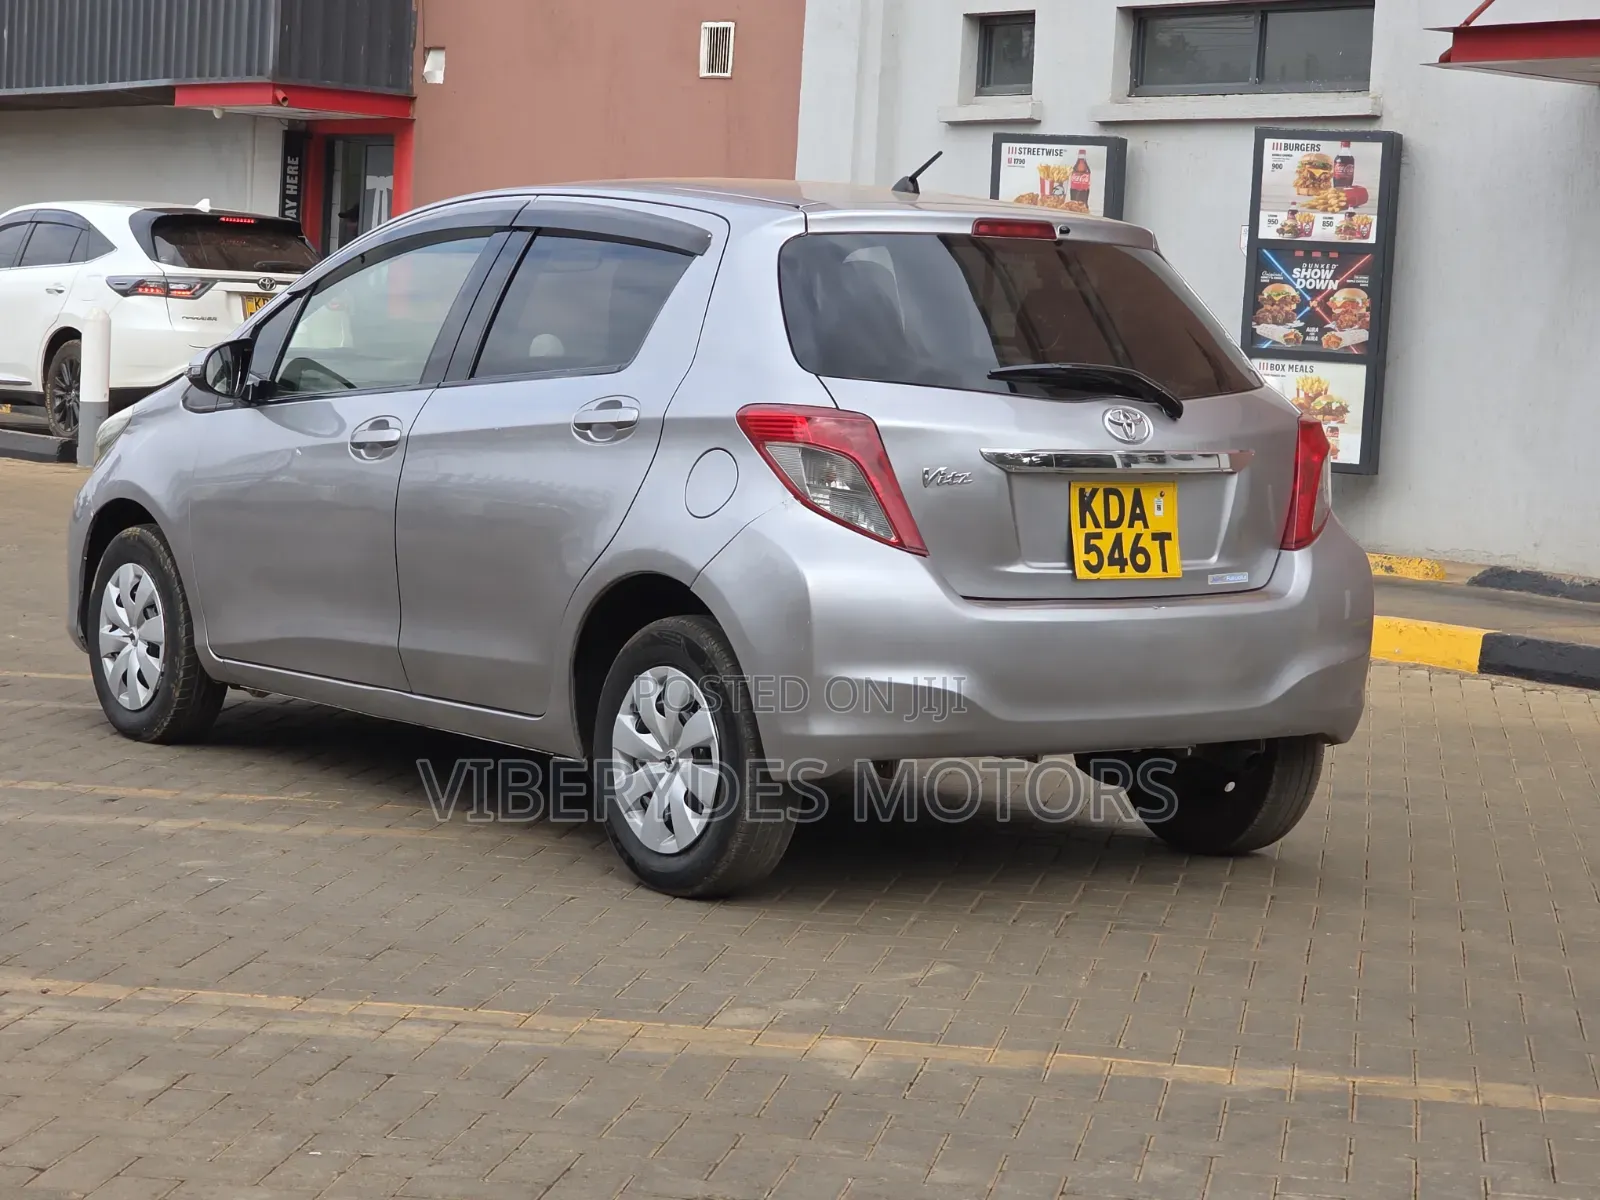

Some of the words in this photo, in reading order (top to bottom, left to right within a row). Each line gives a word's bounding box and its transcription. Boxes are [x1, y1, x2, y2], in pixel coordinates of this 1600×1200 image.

[1018, 147, 1064, 157] STREETWISE
[1283, 143, 1321, 152] BURGERS
[285, 156, 299, 195] HERE
[284, 199, 298, 220] AY
[1322, 220, 1334, 228] 850
[1292, 268, 1334, 279] SHOW
[1296, 279, 1339, 290] DOWN
[1269, 363, 1286, 372] BOX
[1288, 364, 1315, 374] MEALS
[922, 466, 973, 488] Vitz
[1078, 487, 1149, 530] KDA
[1082, 531, 1173, 574] 546T
